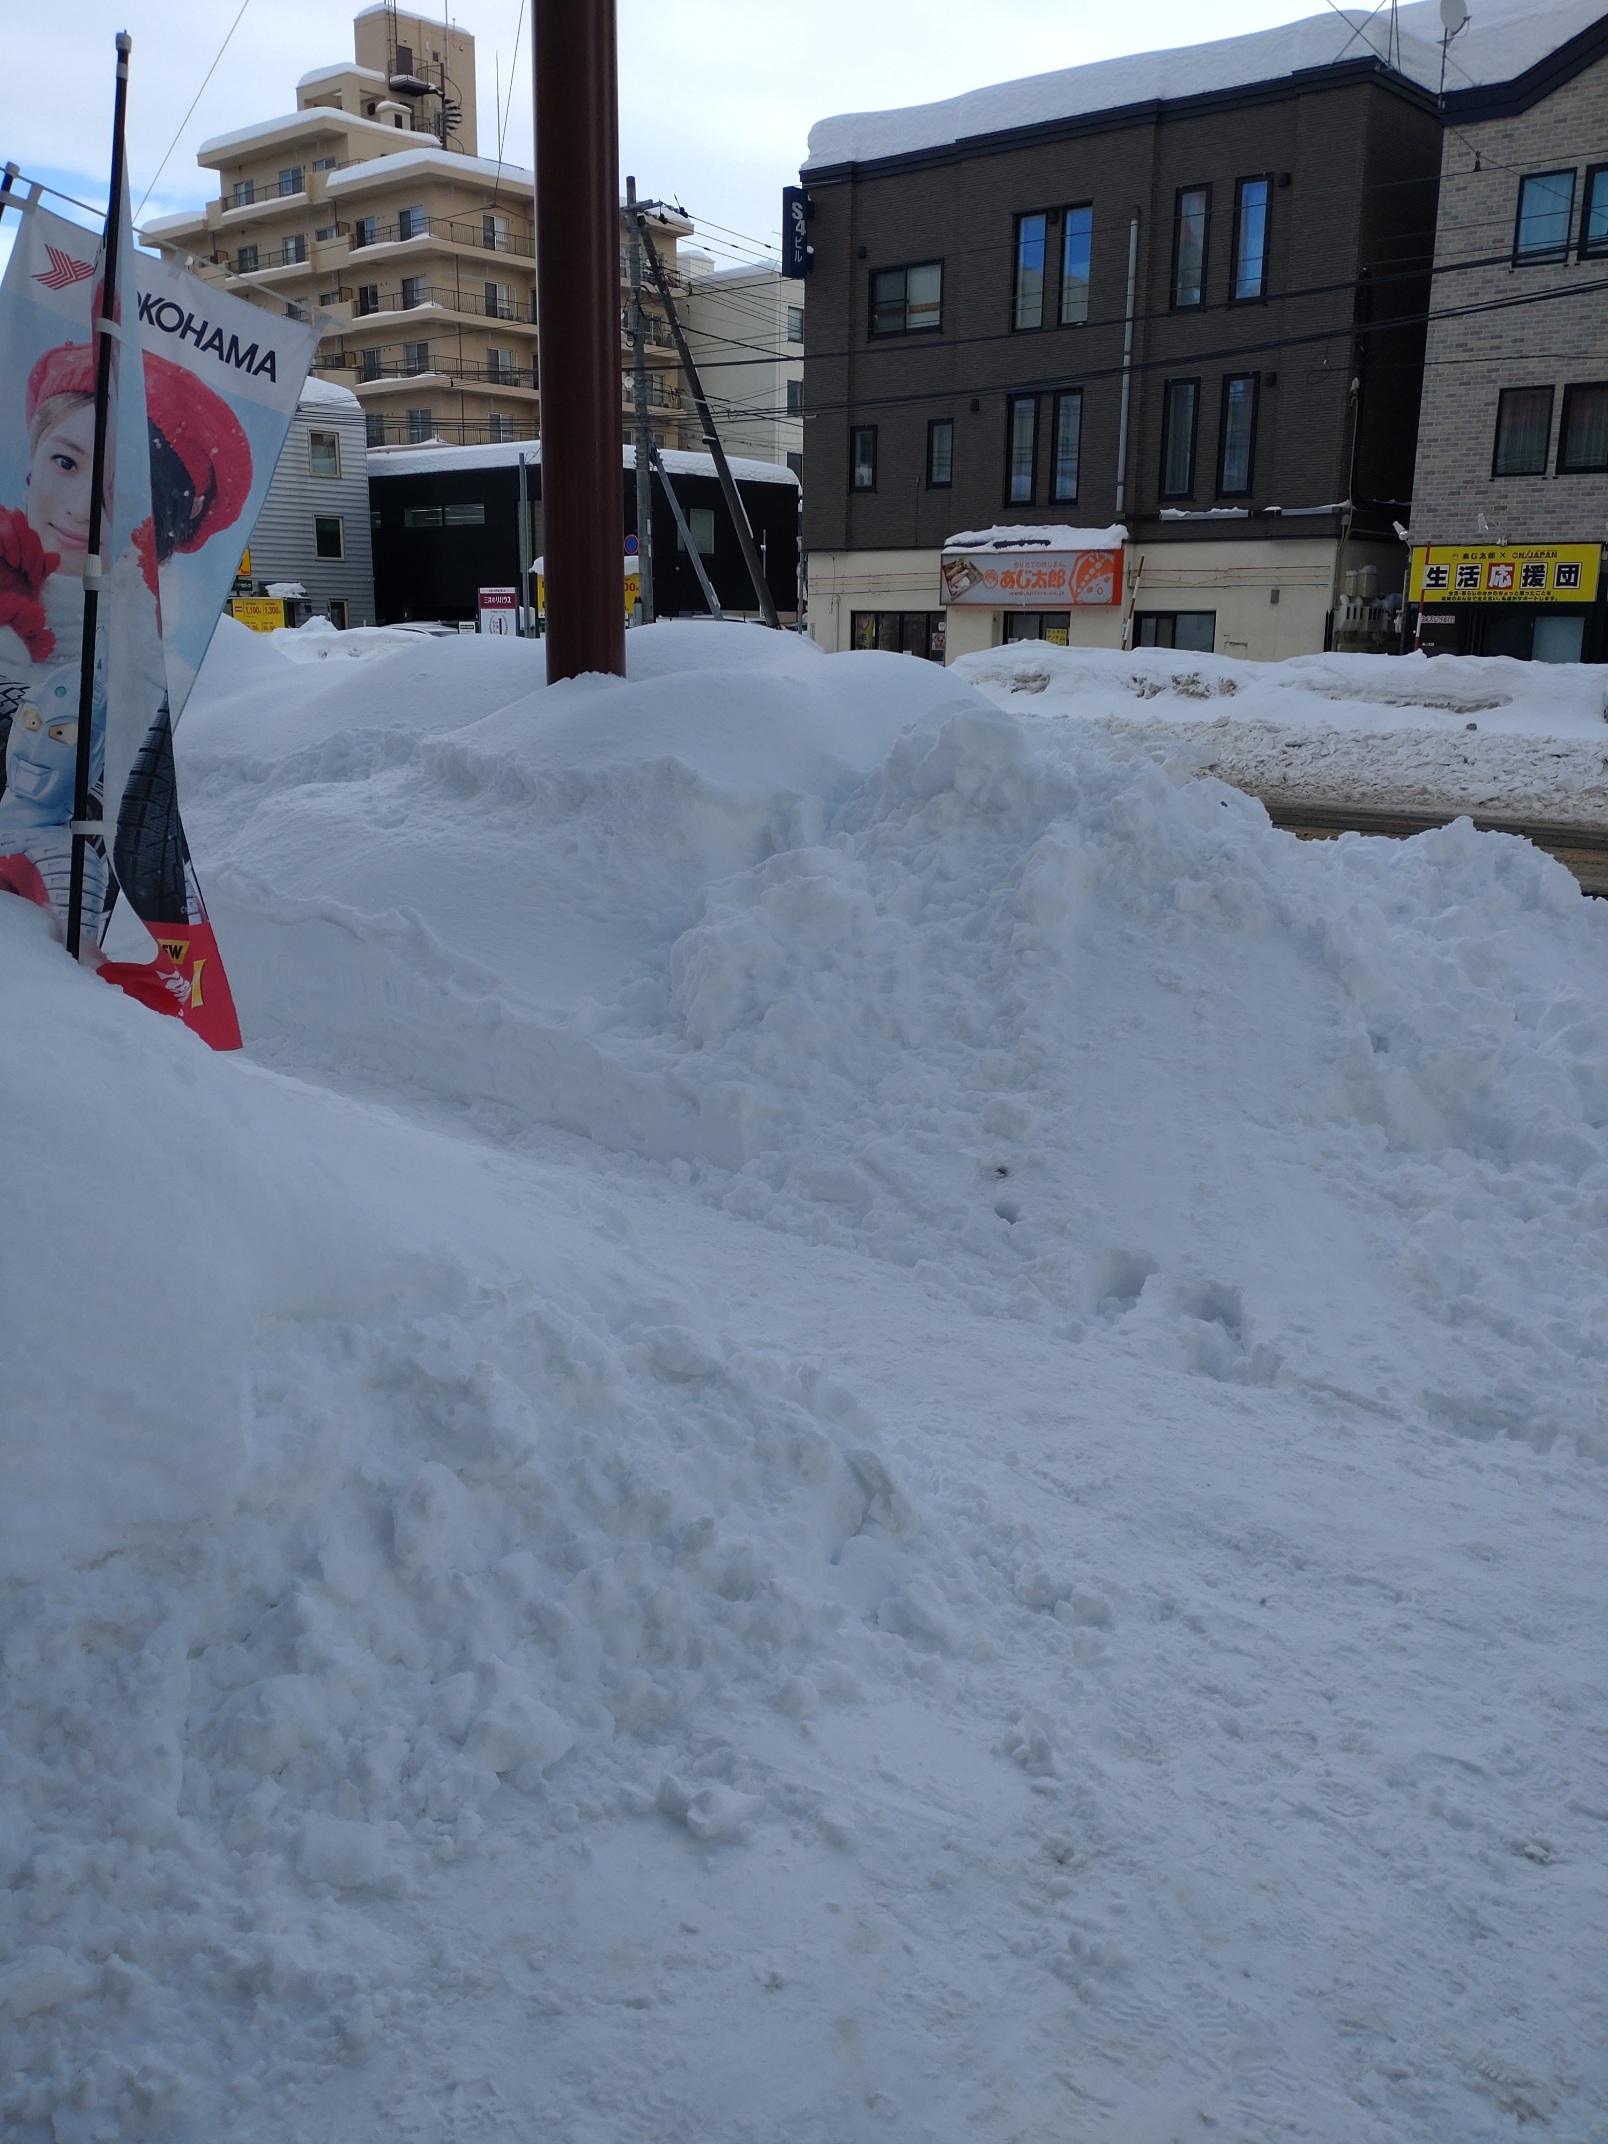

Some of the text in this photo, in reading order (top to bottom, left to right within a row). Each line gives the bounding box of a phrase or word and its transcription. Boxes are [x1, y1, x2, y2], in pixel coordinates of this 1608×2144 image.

[791, 202, 807, 263] S4ビル
[137, 290, 277, 384] KOHAMA
[1000, 568, 1066, 589] あじ太郎
[1426, 564, 1580, 587] 生活応援団
[162, 944, 183, 960] EW
